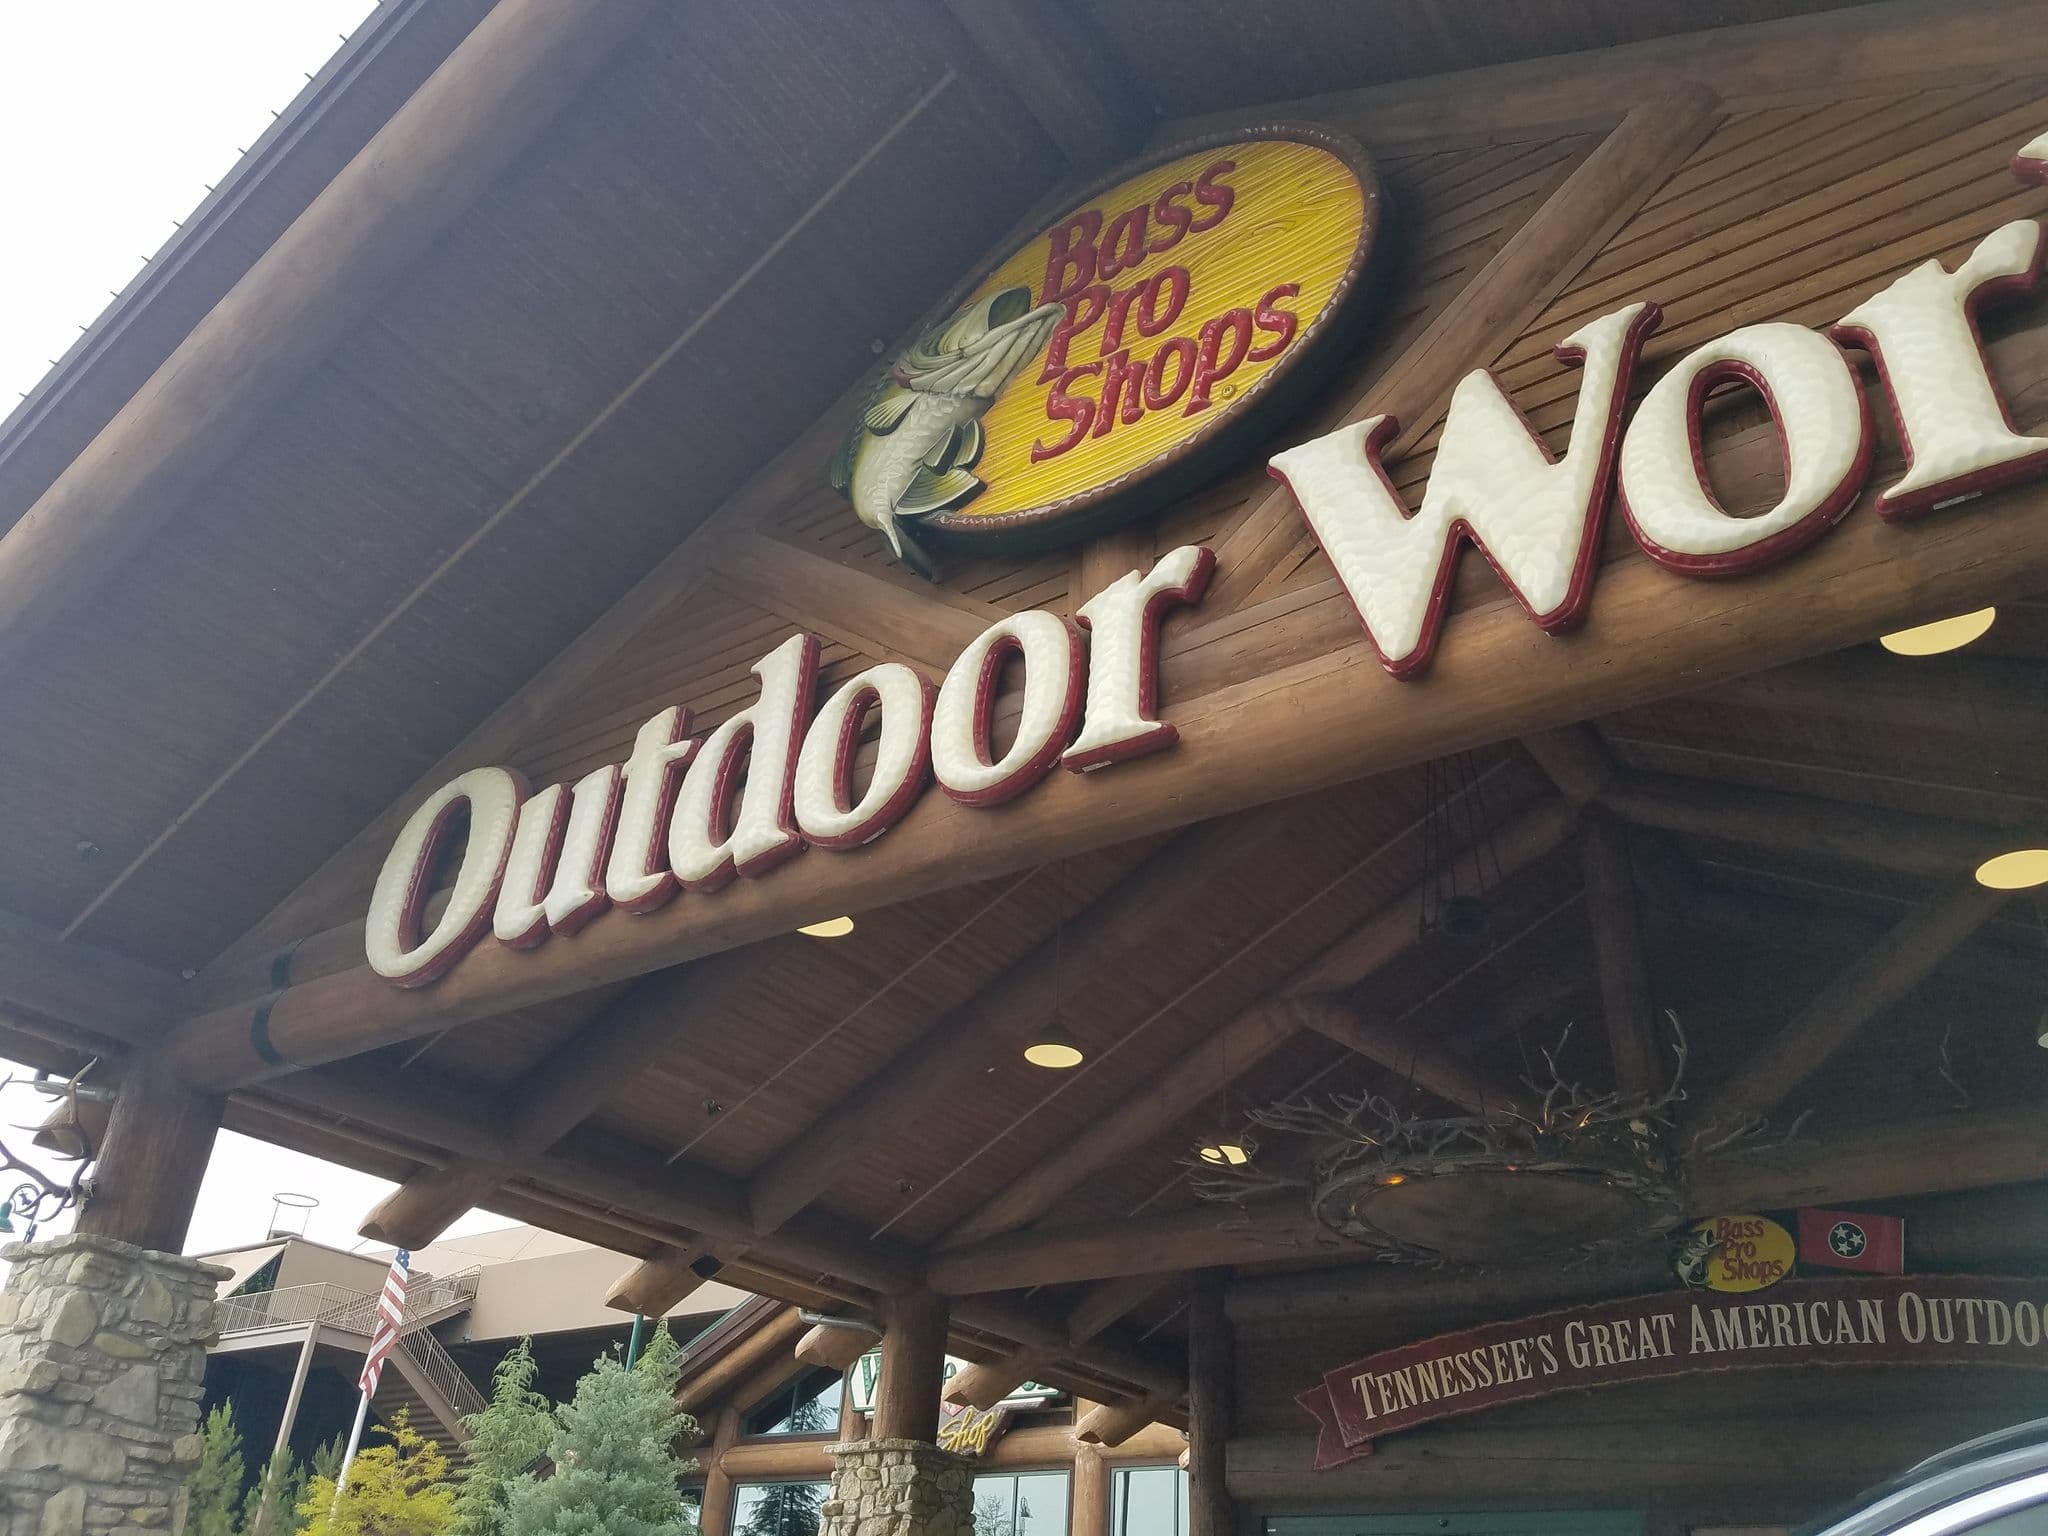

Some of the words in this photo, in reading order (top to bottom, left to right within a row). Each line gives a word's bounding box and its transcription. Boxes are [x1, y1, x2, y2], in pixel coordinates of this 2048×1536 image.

[1039, 160, 1236, 302] Bass
[1030, 283, 1300, 464] Shops
[1036, 265, 1190, 385] Pro
[365, 545, 1216, 988] Outdoor
[1267, 132, 2048, 682] Wor
[1715, 1217, 1765, 1240] Bass
[1720, 1238, 1757, 1259] Pro
[1722, 1257, 1784, 1284] Shops
[1351, 1333, 1559, 1420] TENNESSEE'S
[1564, 1312, 1676, 1370] GREAT
[1688, 1303, 1887, 1355] AMERICAN
[938, 1408, 997, 1456] Shop
